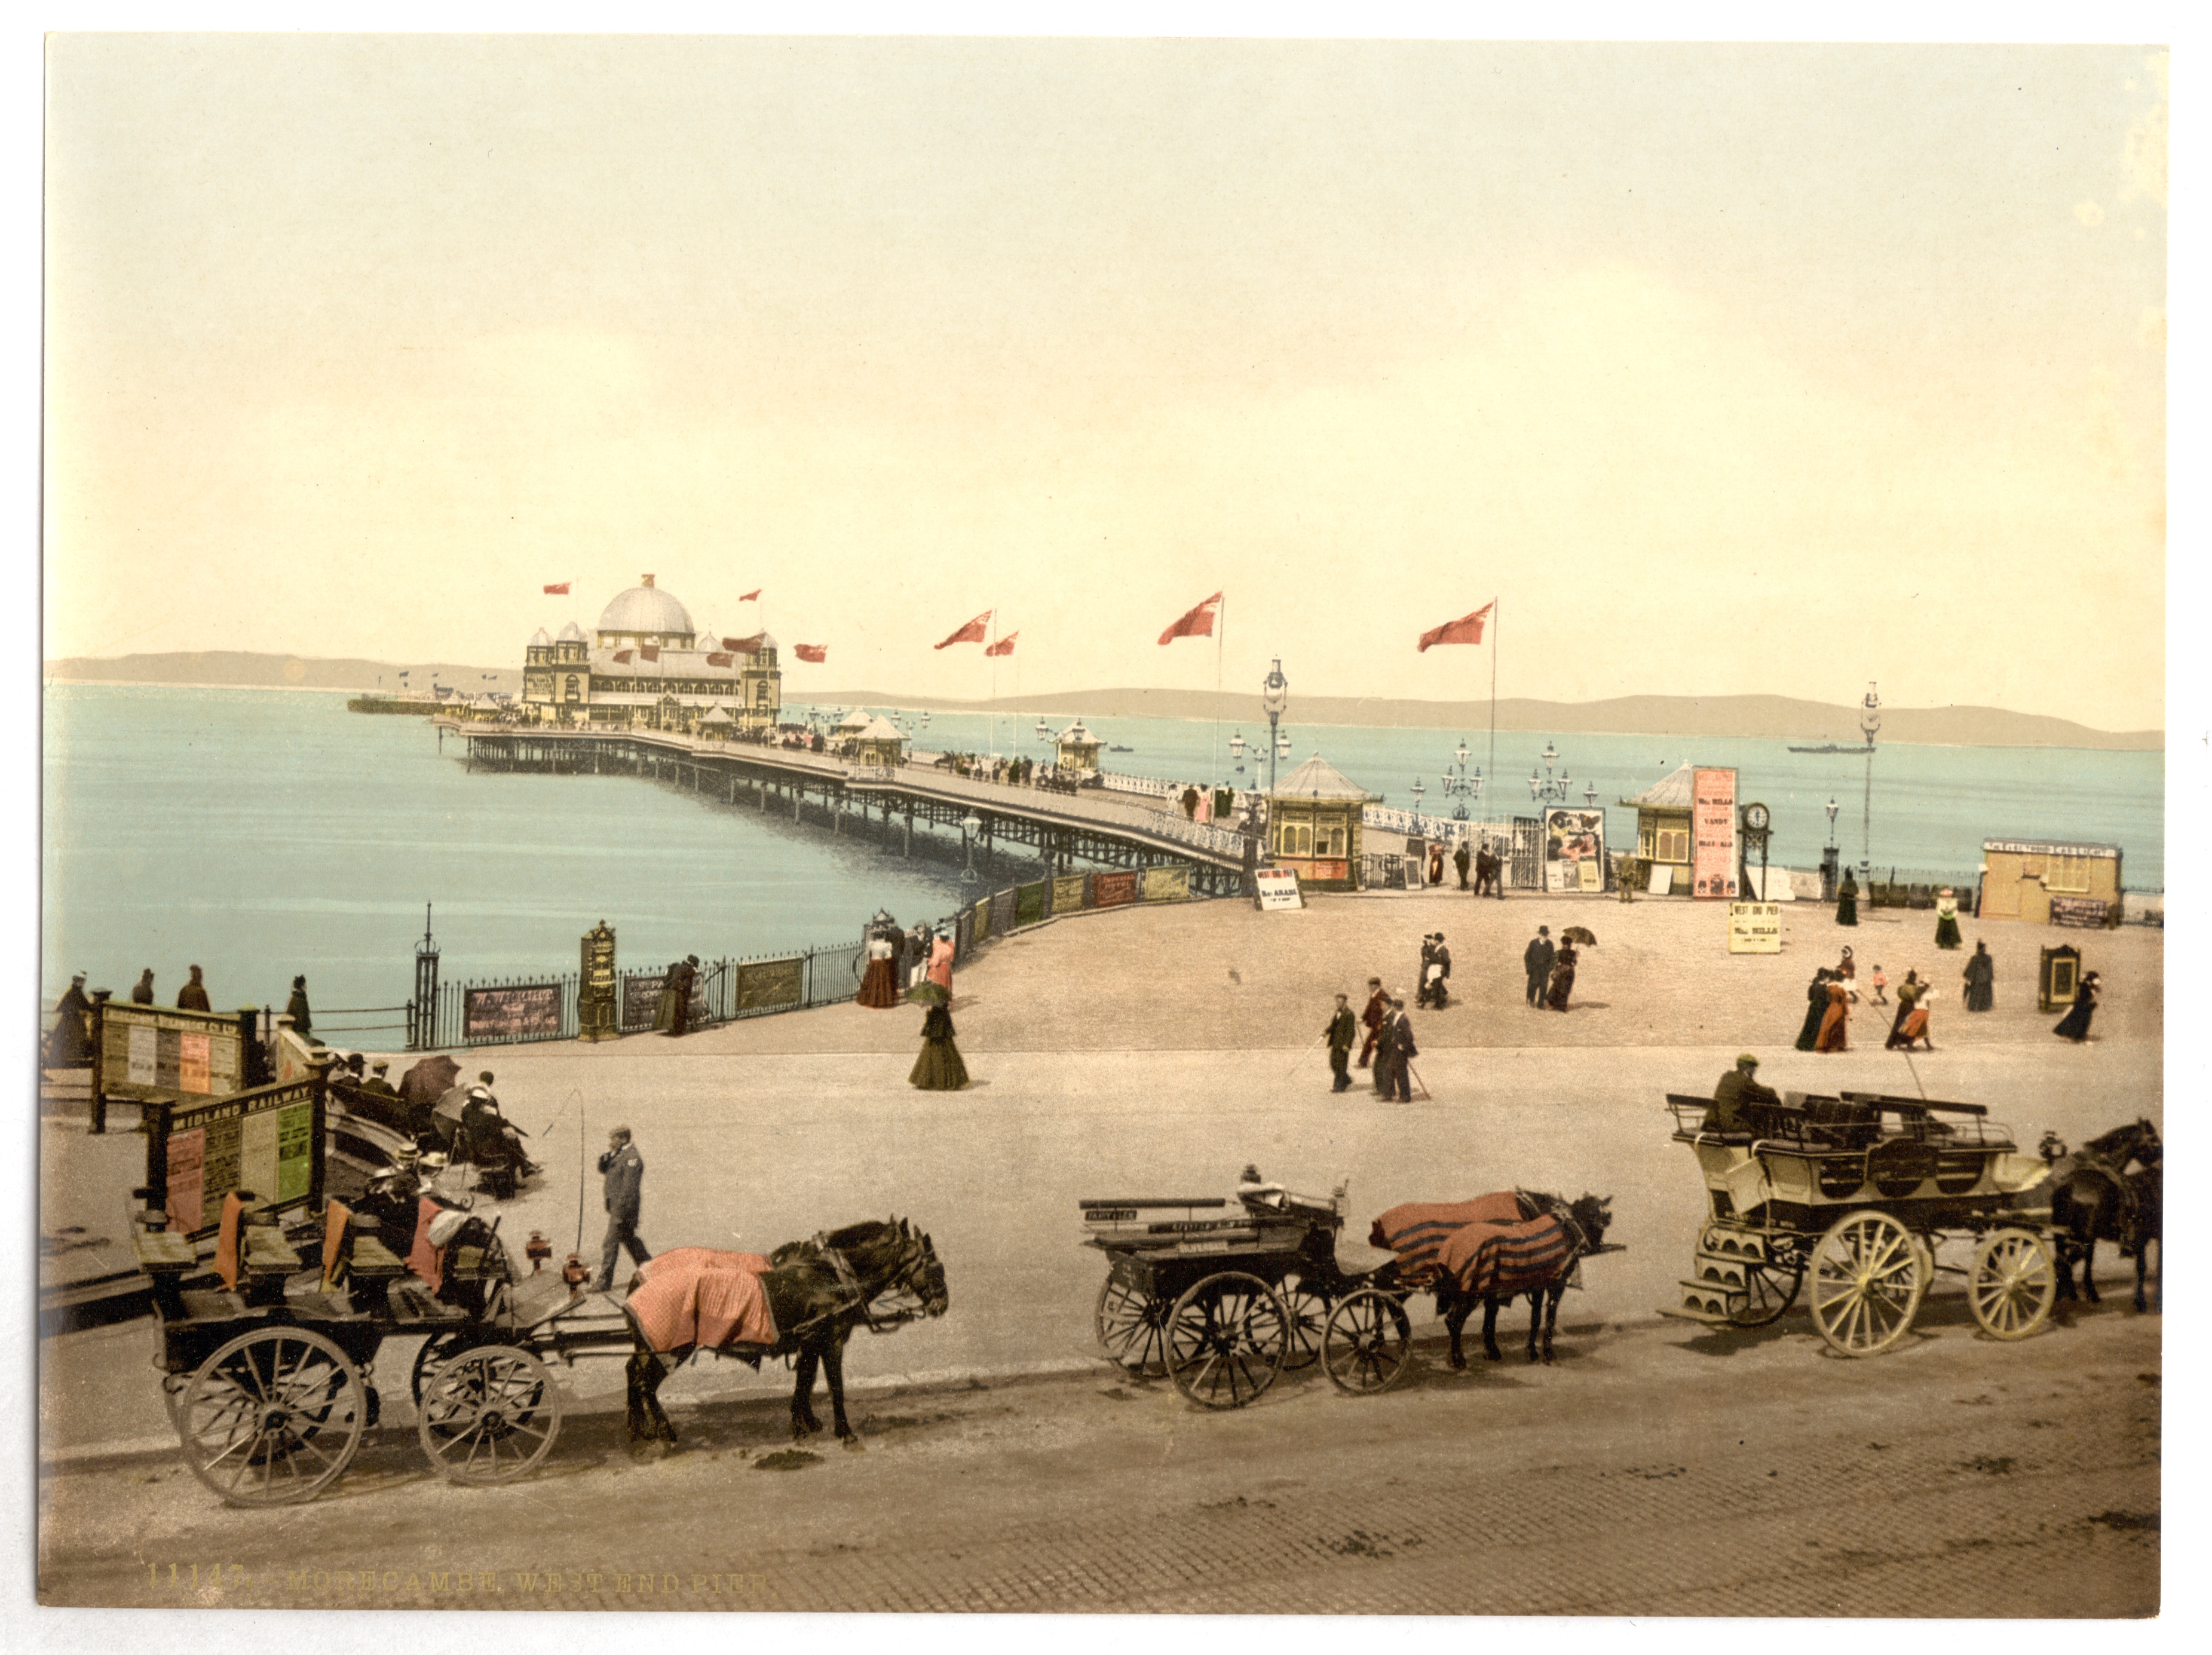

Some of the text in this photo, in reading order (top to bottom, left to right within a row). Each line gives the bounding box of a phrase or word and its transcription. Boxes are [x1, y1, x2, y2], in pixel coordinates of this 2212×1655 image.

[1735, 905, 1748, 915] WEST
[1766, 905, 1779, 915] PIER
[172, 1086, 310, 1130] MIDLAND RAILWAY
